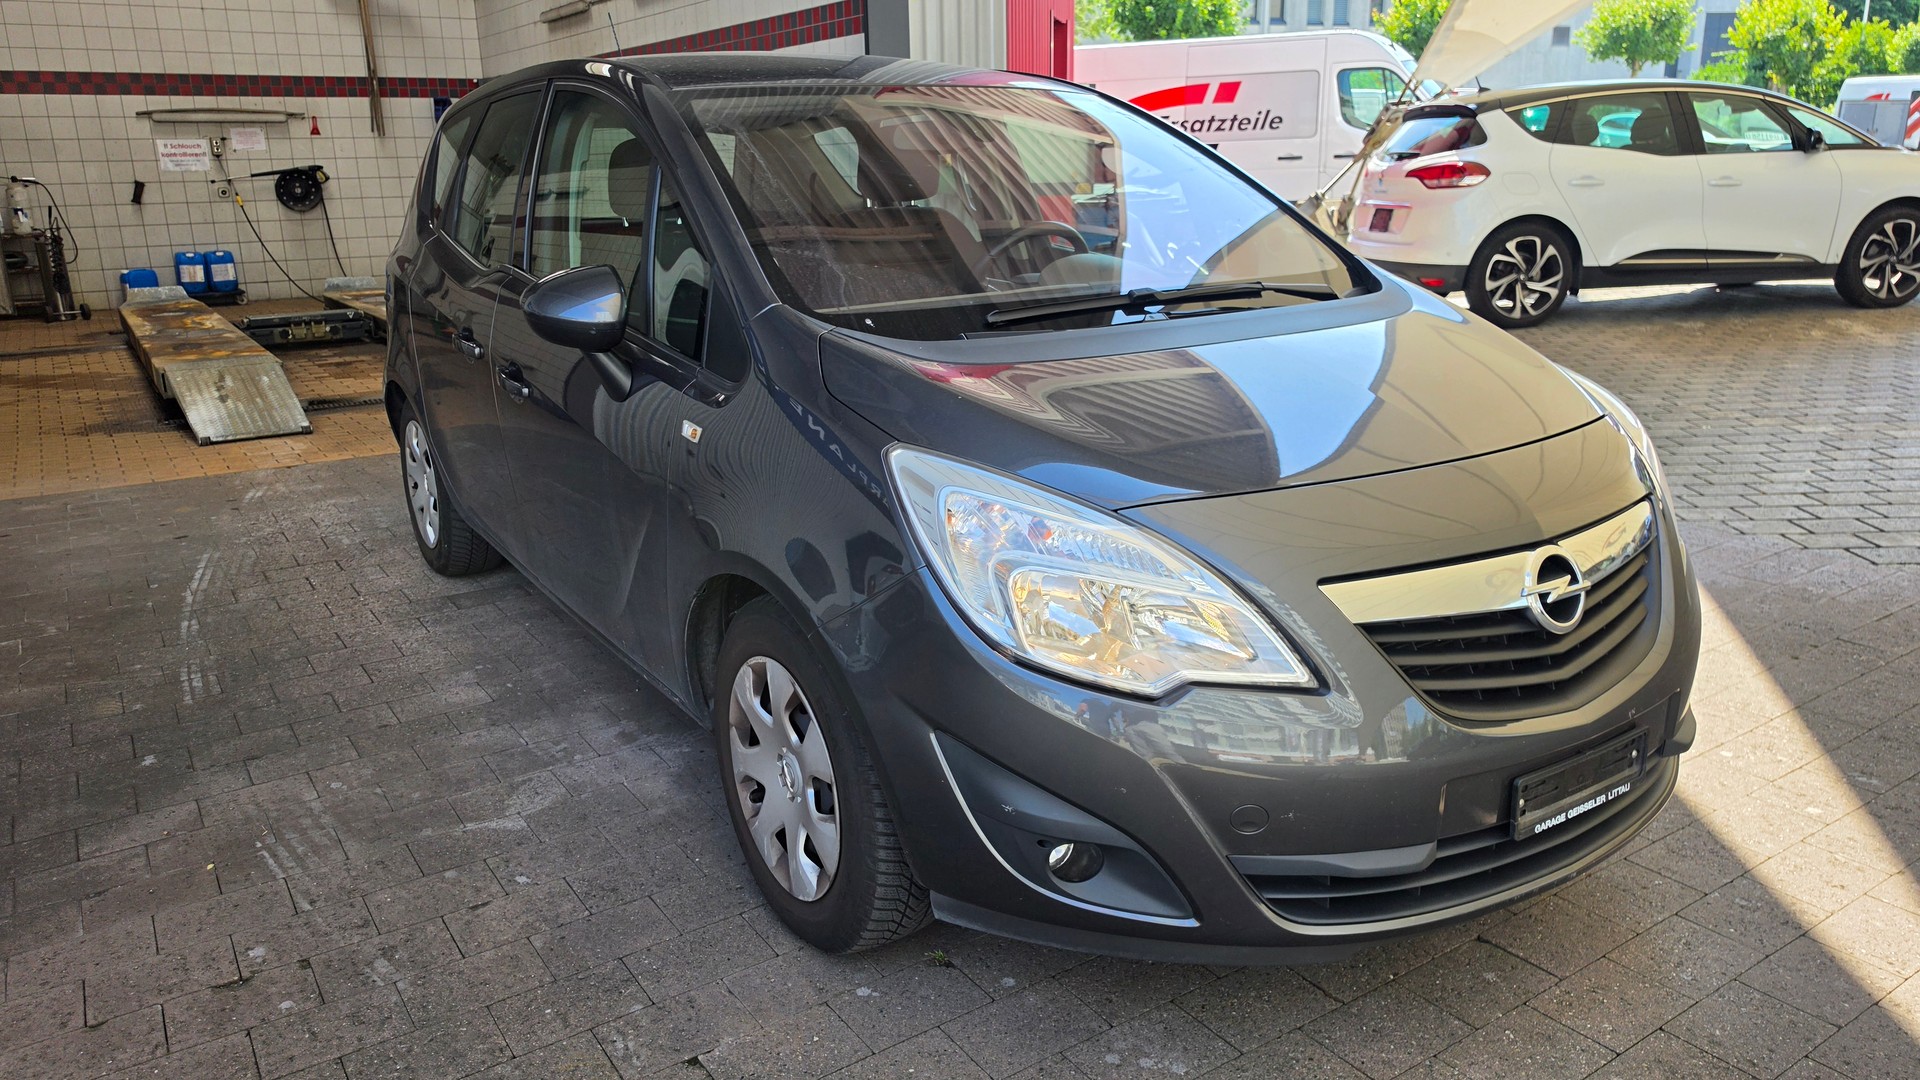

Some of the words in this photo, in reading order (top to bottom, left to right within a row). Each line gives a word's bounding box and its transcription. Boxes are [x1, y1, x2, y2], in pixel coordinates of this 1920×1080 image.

[1160, 109, 1283, 133] satzteile
[1534, 812, 1566, 834] GARAGE
[1567, 794, 1606, 819] GEISSELER
[1608, 782, 1631, 800] LITTAU
